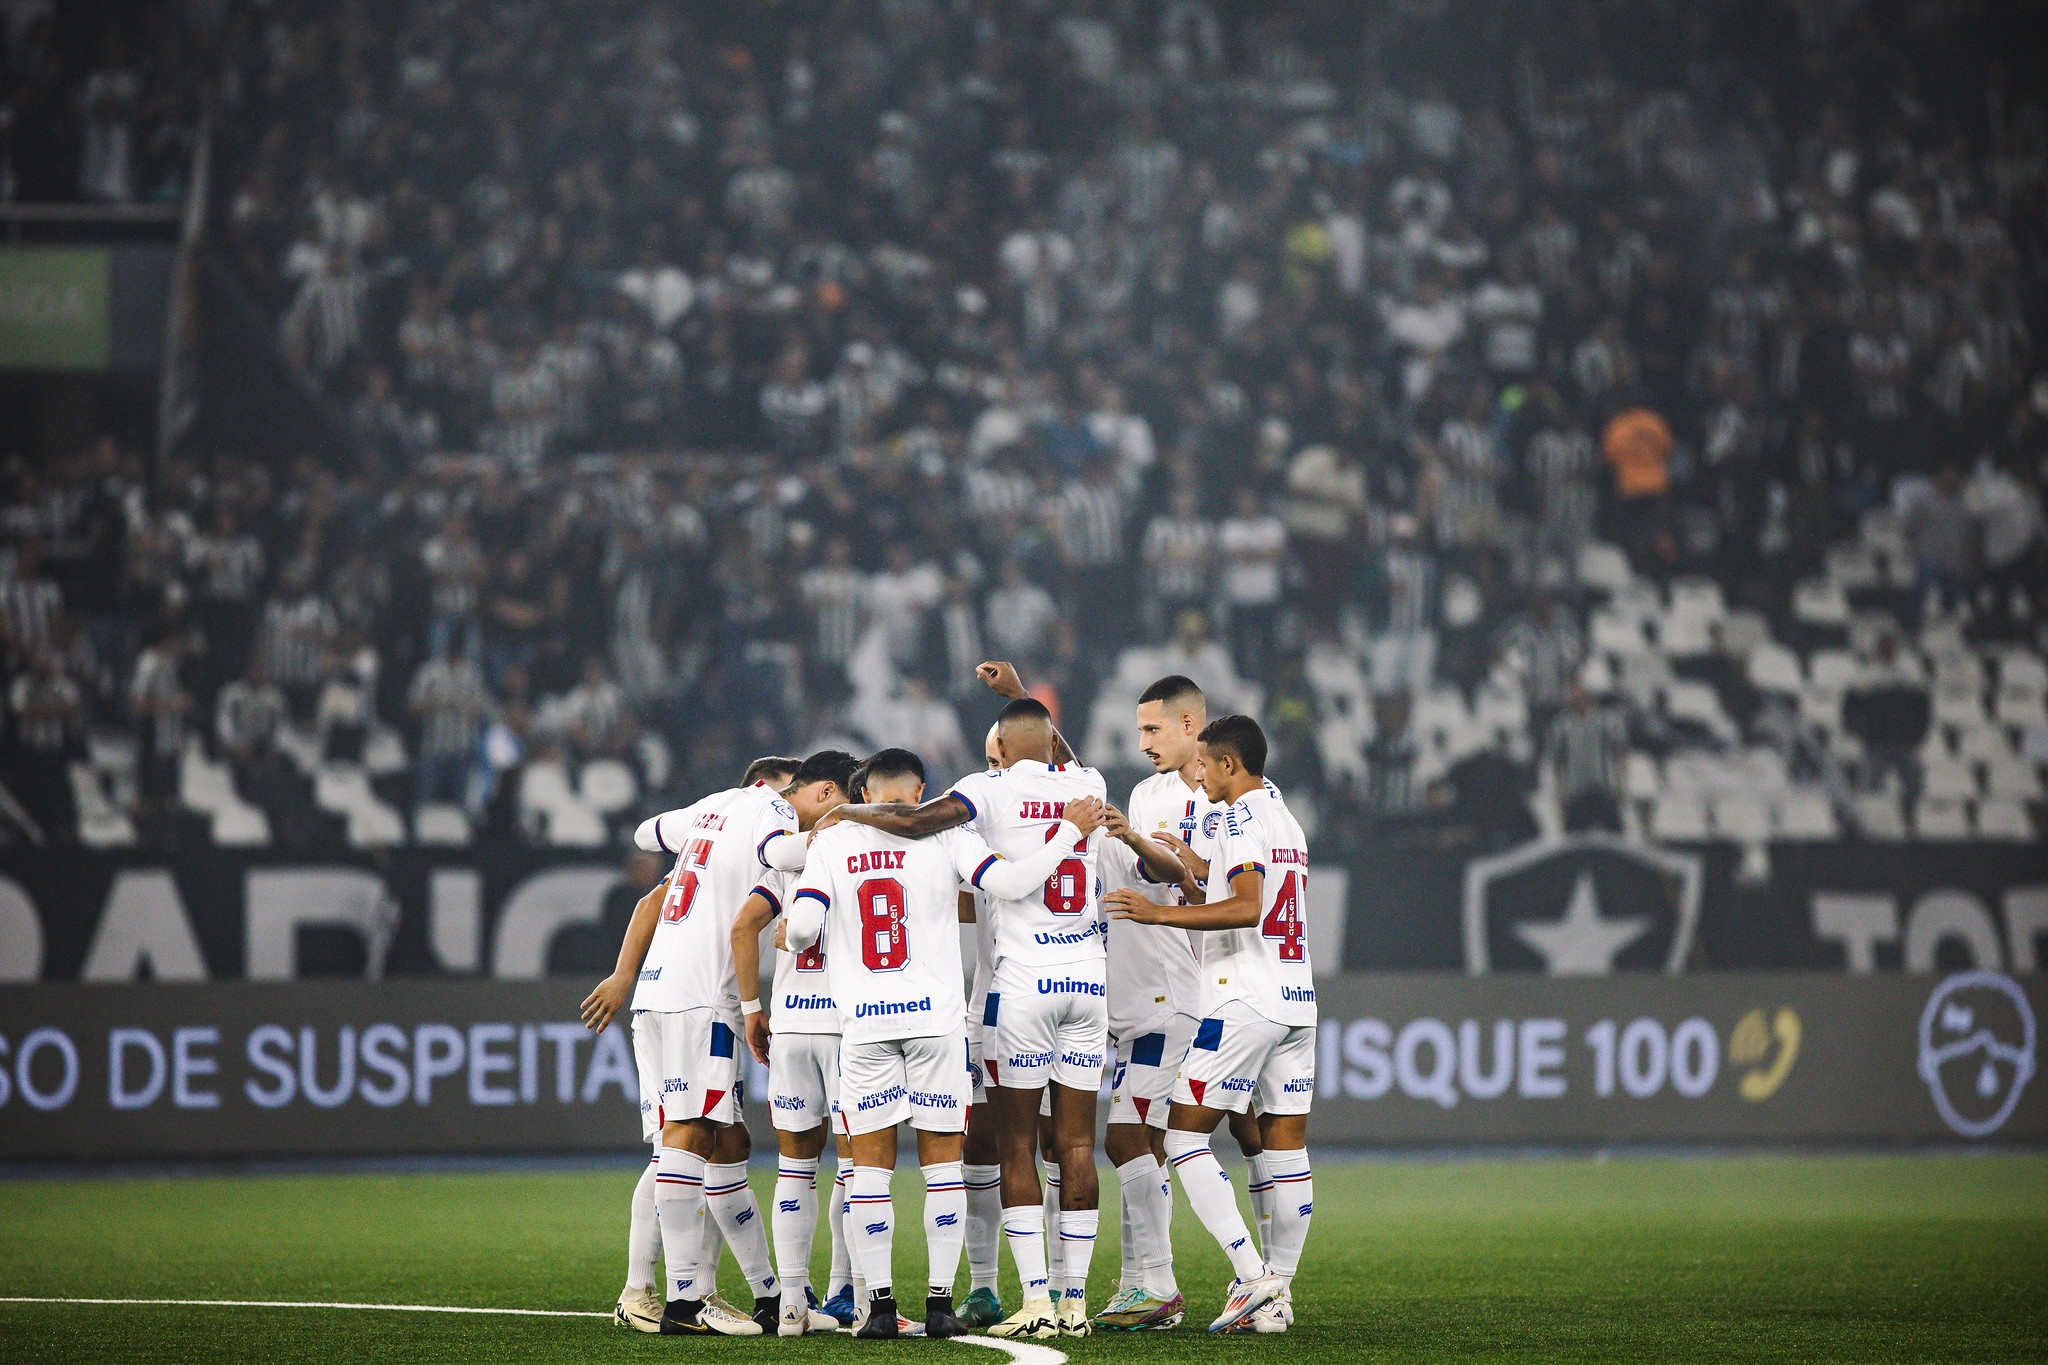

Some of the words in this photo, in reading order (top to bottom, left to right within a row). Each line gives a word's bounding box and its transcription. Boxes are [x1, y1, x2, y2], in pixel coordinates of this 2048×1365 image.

[1020, 802, 1064, 818] JEAN
[1179, 821, 1197, 830] DULAR
[847, 850, 906, 874] CAULY
[857, 877, 912, 974] 8
[1262, 870, 1307, 963] 4
[855, 997, 932, 1018] Unimed
[0, 1024, 80, 1111] O
[109, 1026, 221, 1109] DE
[245, 1022, 640, 1107] SUSPEITA
[1585, 1017, 1721, 1099] 100
[858, 1087, 907, 1112] MULTIVIX
[863, 1085, 900, 1101] FACULDADE
[909, 1094, 957, 1109] MULTIVIX
[913, 1091, 952, 1100] FACULDADE
